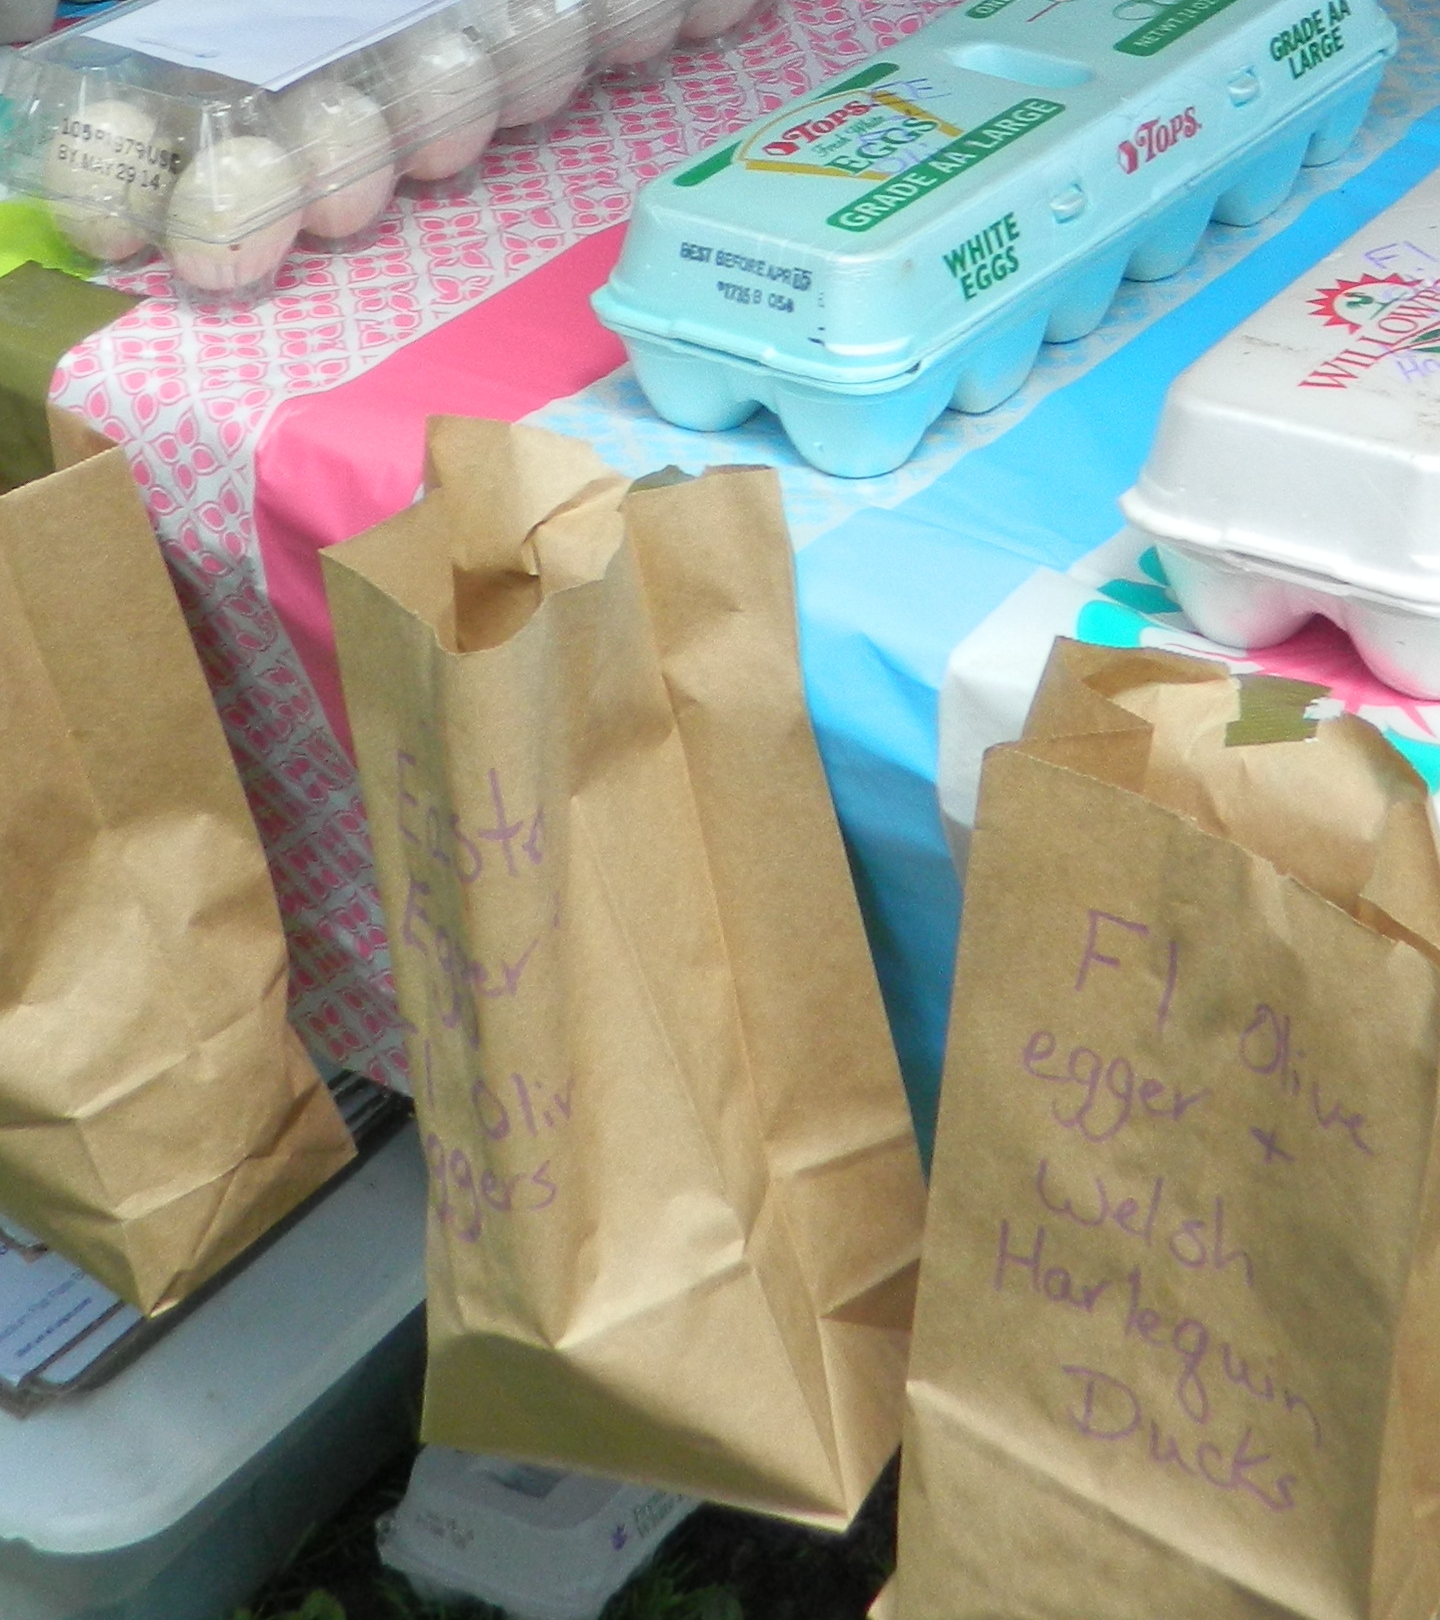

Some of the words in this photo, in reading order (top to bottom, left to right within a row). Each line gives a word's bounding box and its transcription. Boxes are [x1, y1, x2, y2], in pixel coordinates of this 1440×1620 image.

[1270, 9, 1325, 63] GRADE
[1288, 28, 1345, 80] LARGE
[824, 118, 940, 176] EGGS
[839, 173, 938, 229] GRADE
[937, 147, 978, 174] AA
[971, 100, 1059, 150] LARGE
[679, 242, 713, 264] BEST
[715, 249, 766, 279] BEFORE
[765, 262, 791, 285] APR
[943, 211, 1021, 279] WHITE
[959, 245, 1019, 302] EGGS
[1020, 1023, 1213, 1146] egger
[1236, 1002, 1376, 1156] Olive
[1035, 1159, 1256, 1288] Welsh
[992, 1218, 1326, 1450] Harlequin
[1060, 1364, 1301, 1516] Ducks
